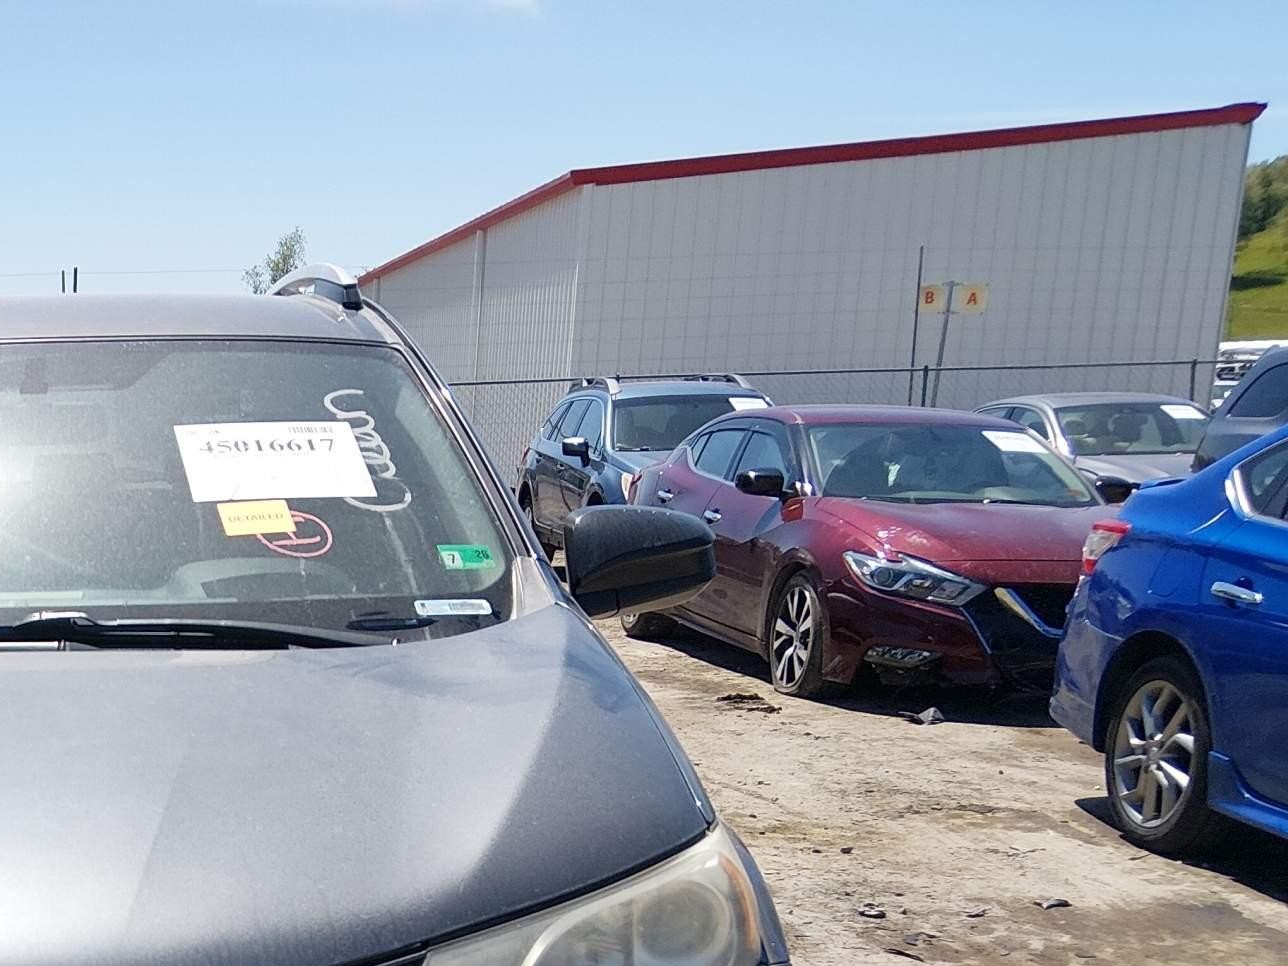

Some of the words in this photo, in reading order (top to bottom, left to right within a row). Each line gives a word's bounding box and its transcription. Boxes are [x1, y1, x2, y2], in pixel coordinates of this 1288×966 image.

[924, 290, 935, 305] B
[965, 291, 978, 306] A
[200, 438, 335, 454] 45016617
[447, 553, 456, 565] 7
